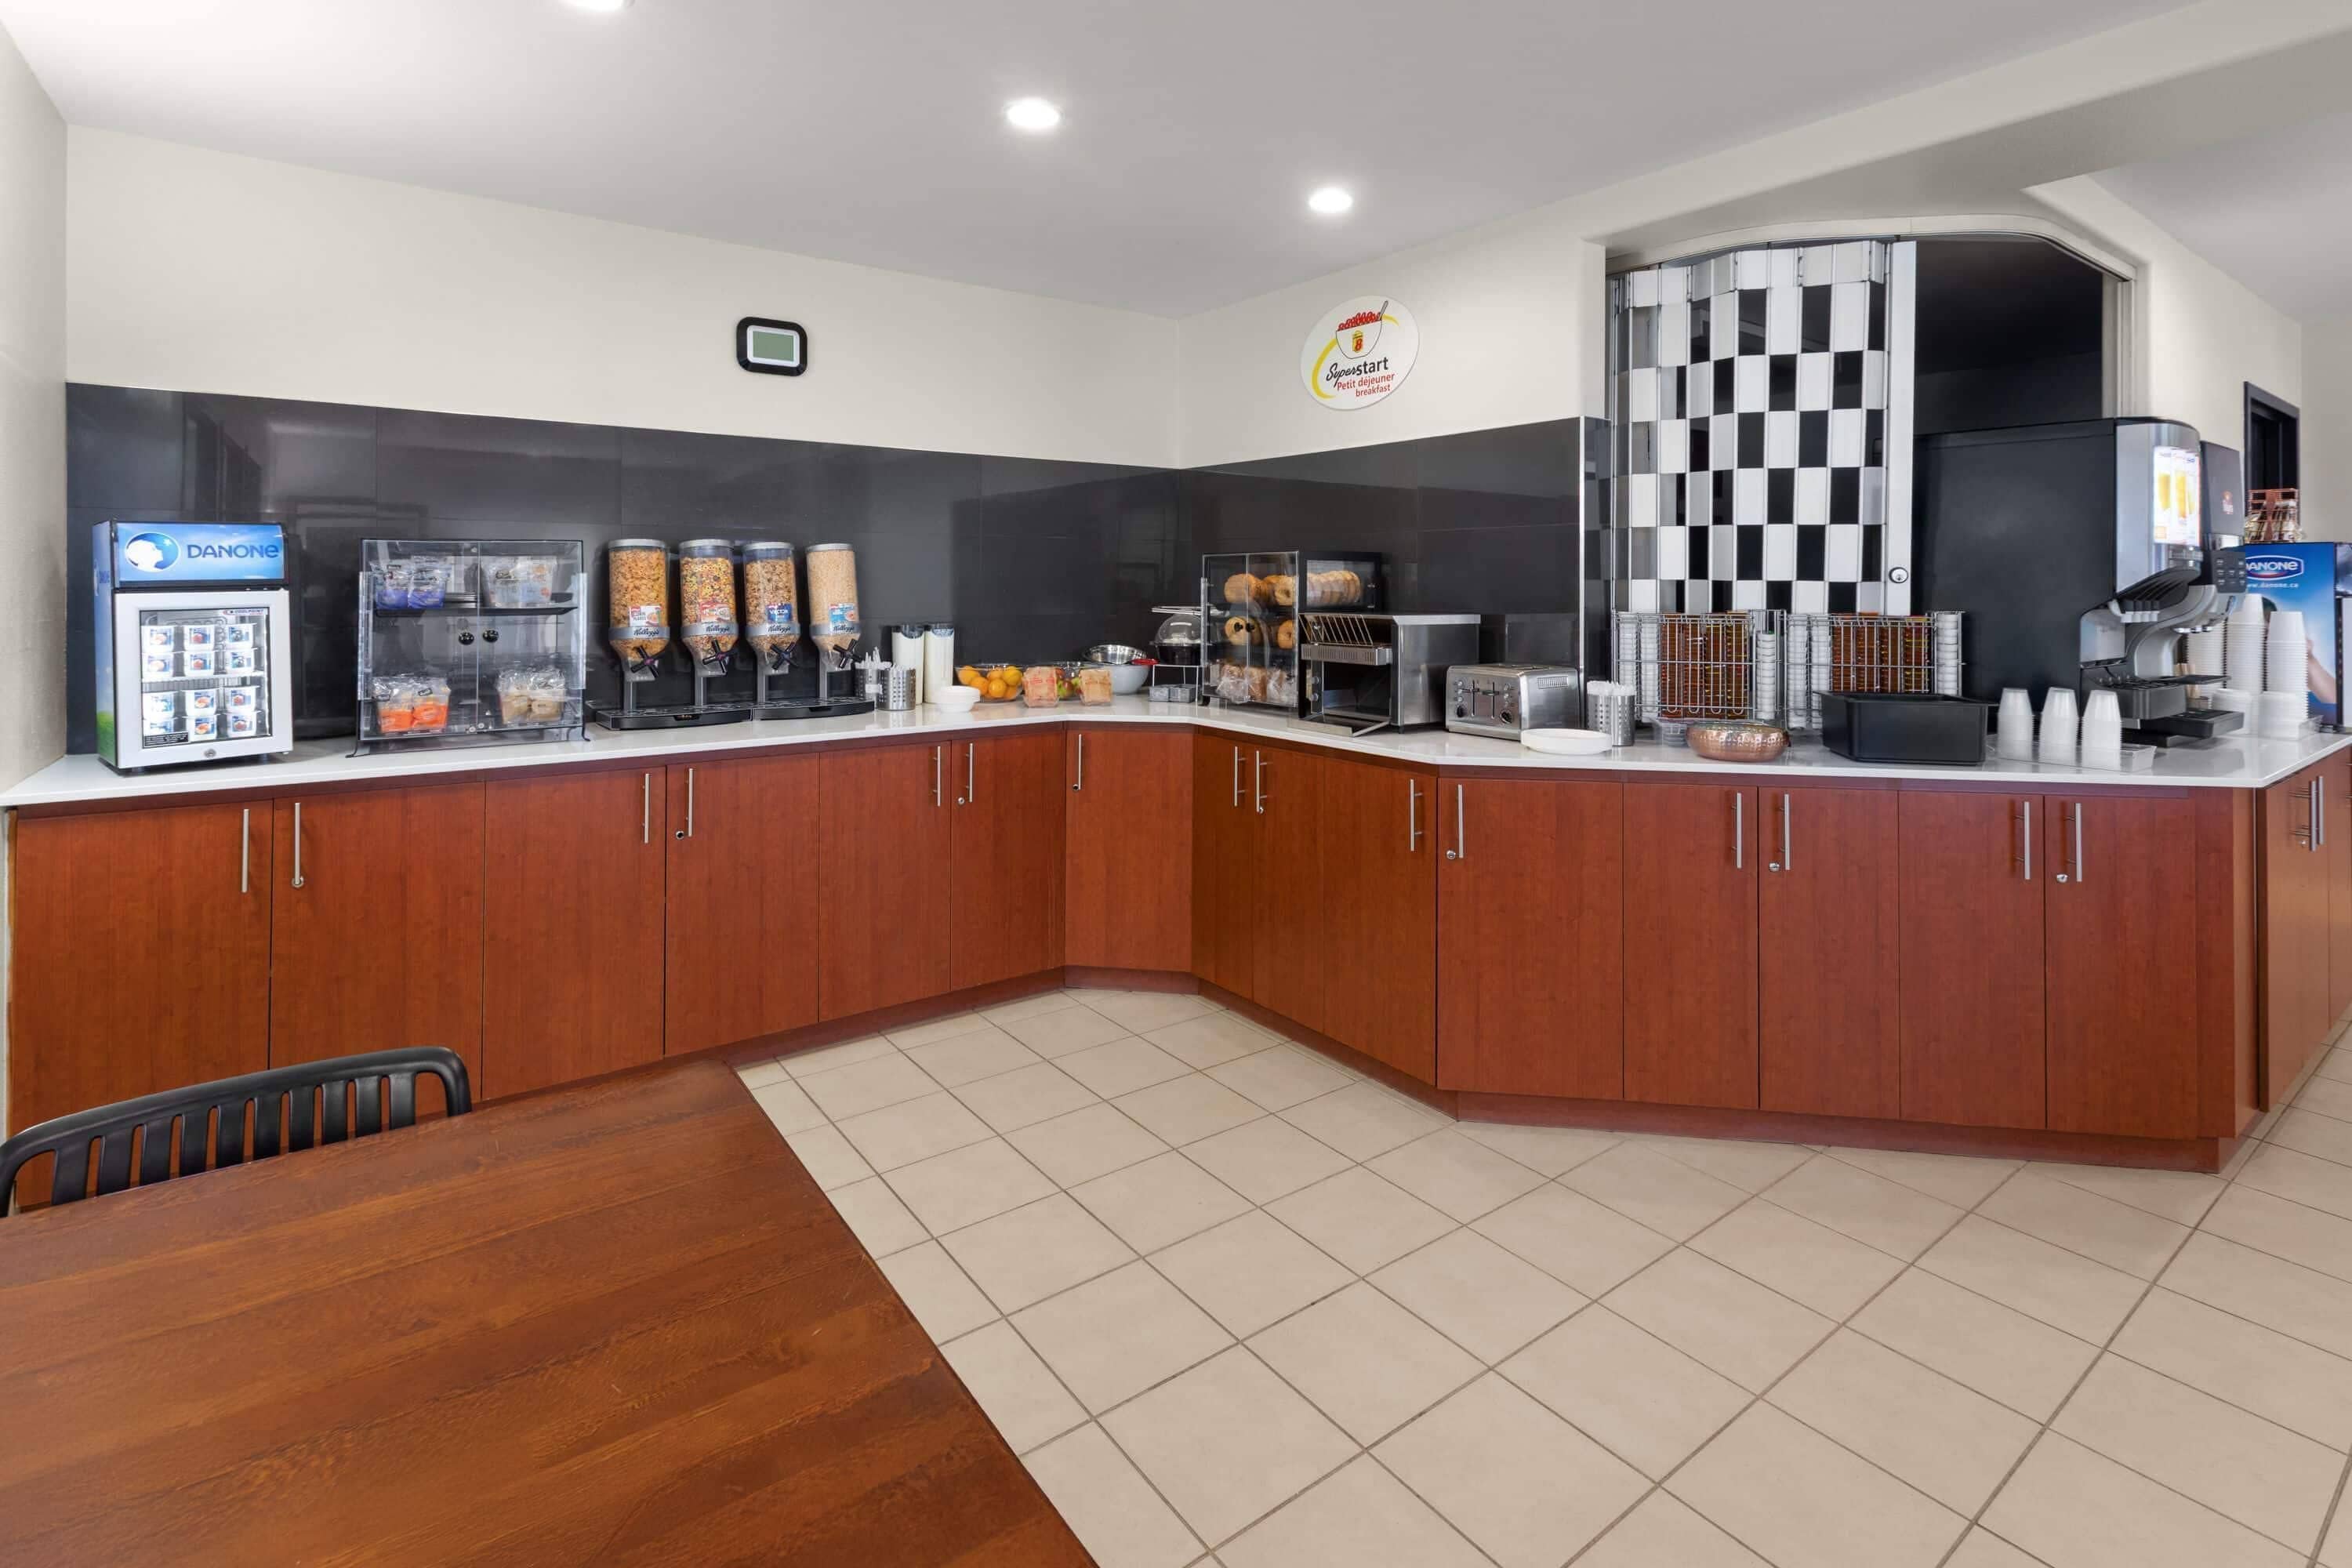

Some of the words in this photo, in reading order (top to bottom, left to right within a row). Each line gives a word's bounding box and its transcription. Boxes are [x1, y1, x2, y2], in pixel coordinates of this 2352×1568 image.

[1355, 339, 1363, 351] 8
[1326, 357, 1388, 388] Superstart
[1337, 379, 1356, 391] Petit
[1358, 372, 1396, 387] déjeuner
[1356, 383, 1391, 397] breakfast
